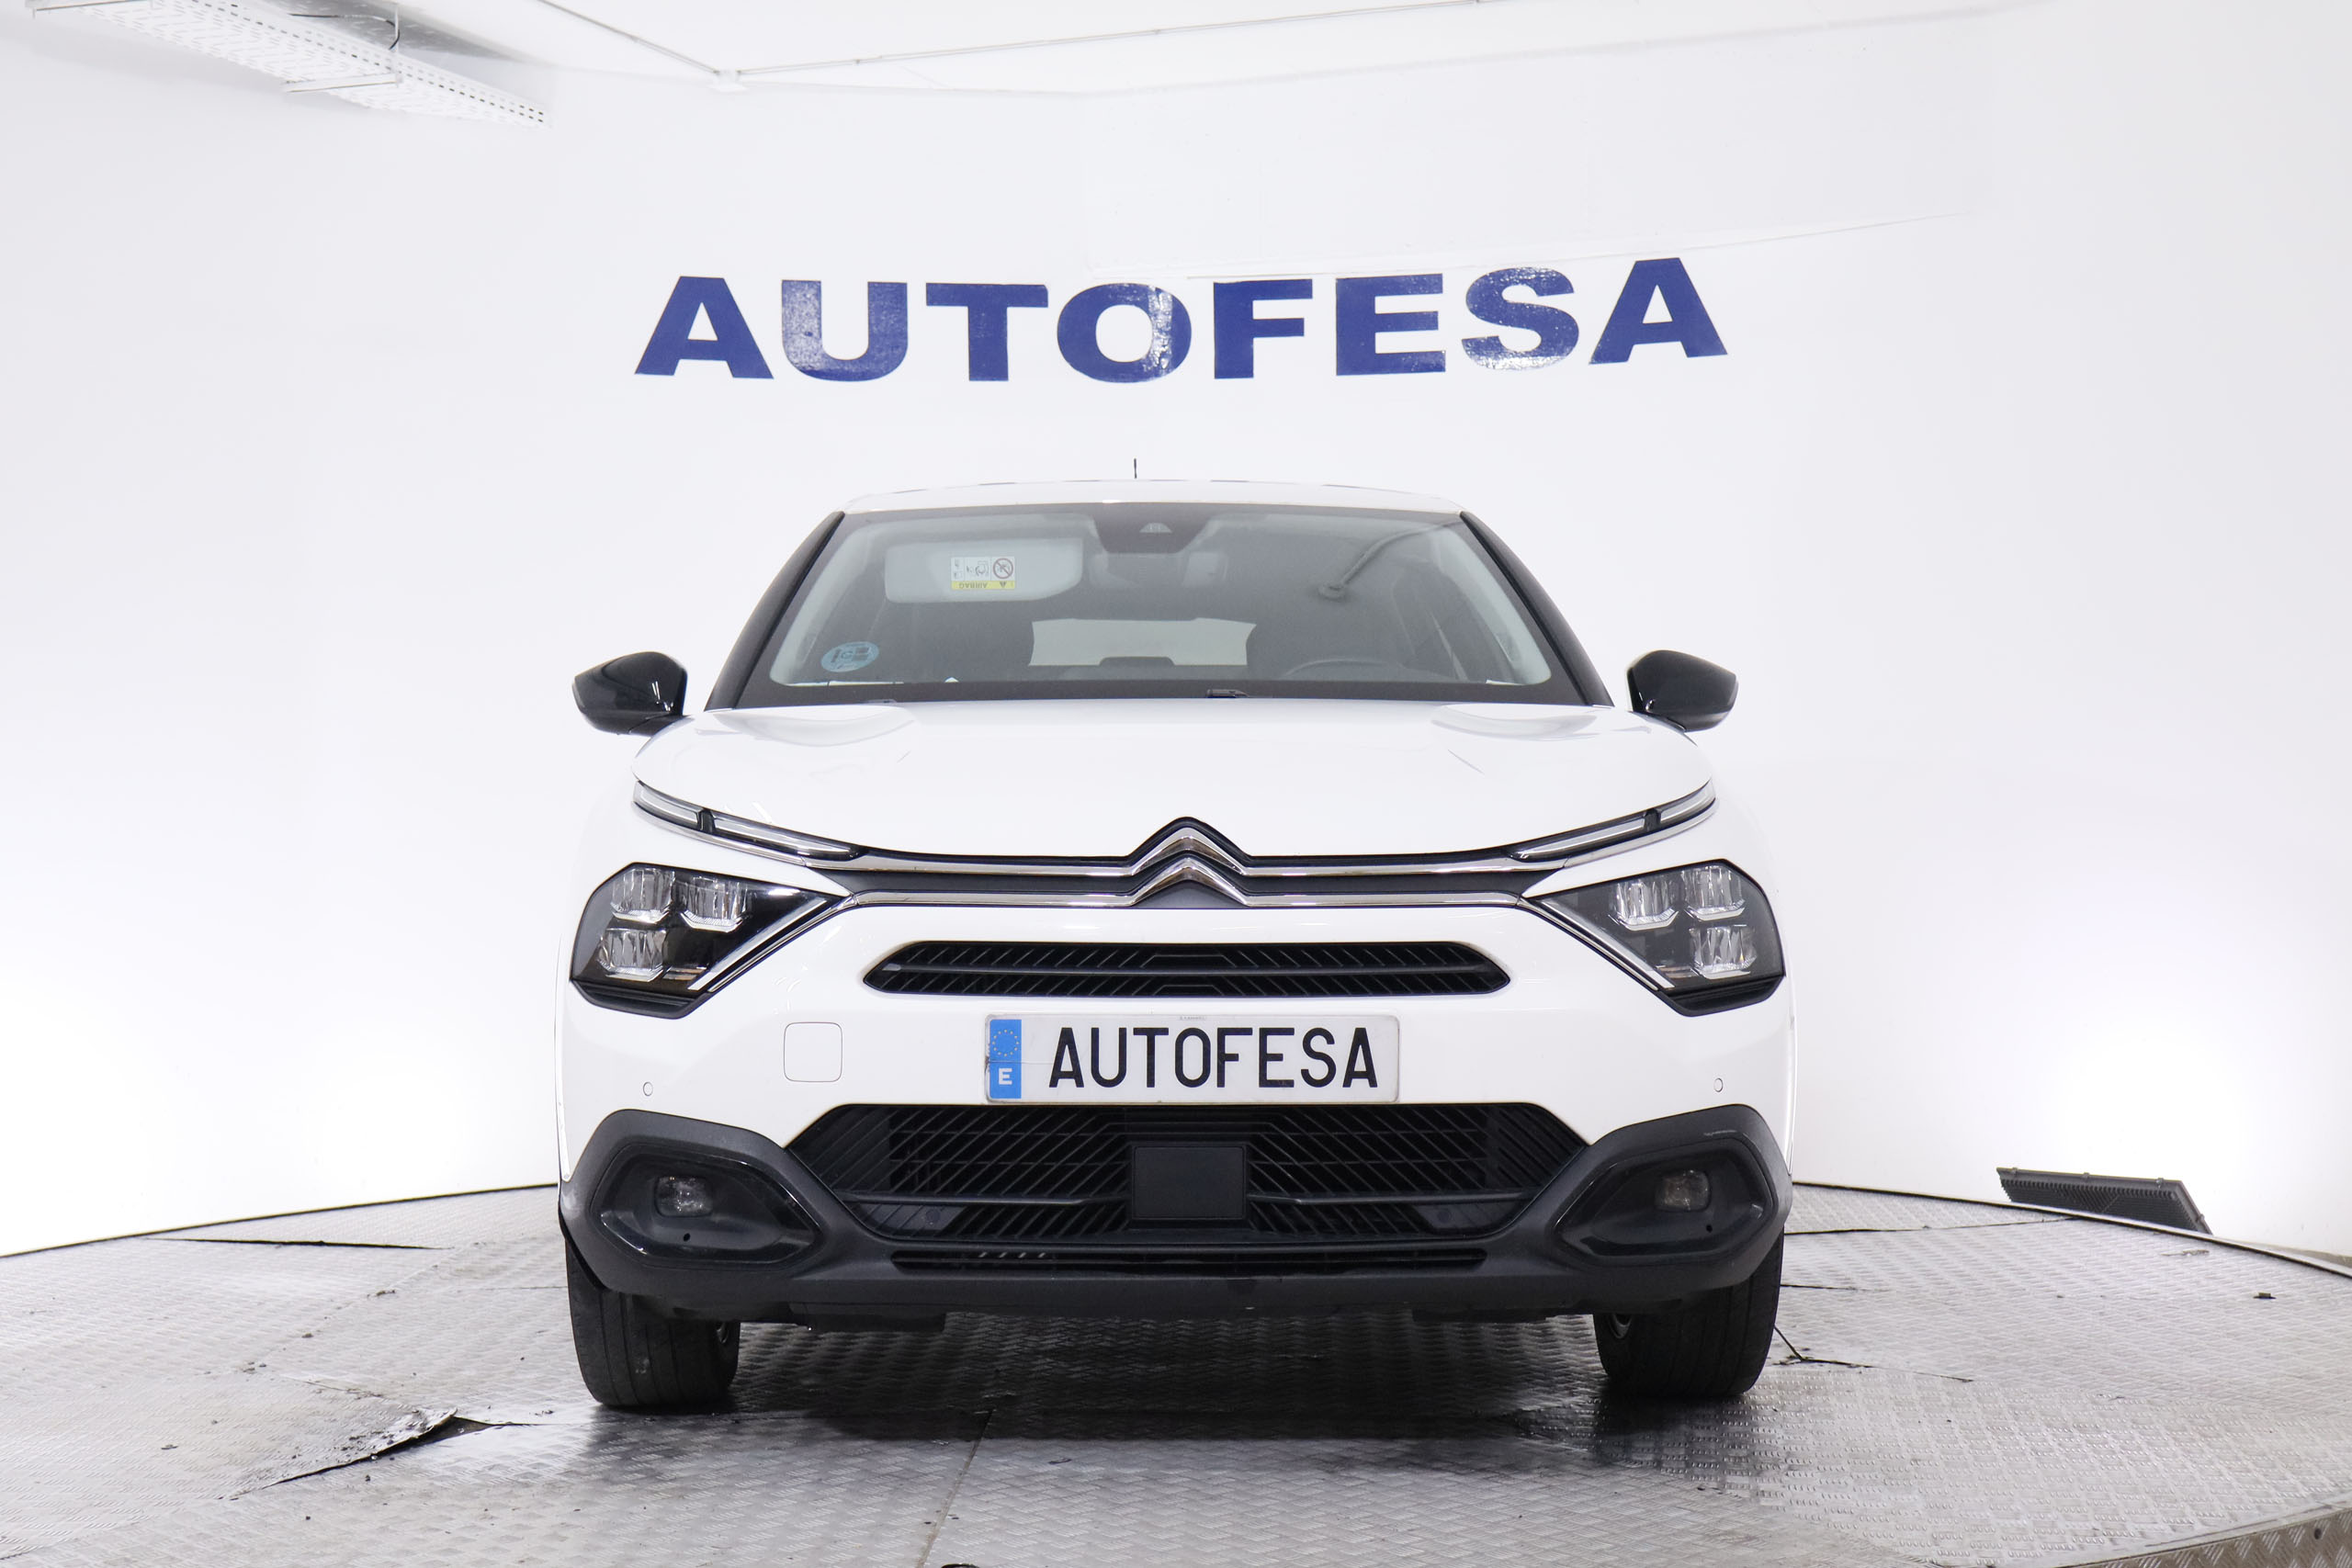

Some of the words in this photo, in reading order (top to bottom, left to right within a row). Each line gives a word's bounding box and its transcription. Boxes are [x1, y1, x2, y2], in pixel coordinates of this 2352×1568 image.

[637, 259, 1728, 383] AUTOFESA
[957, 581, 989, 590] AIRBAG
[998, 1067, 1013, 1086] E
[1048, 1027, 1378, 1089] AUTOFESA
